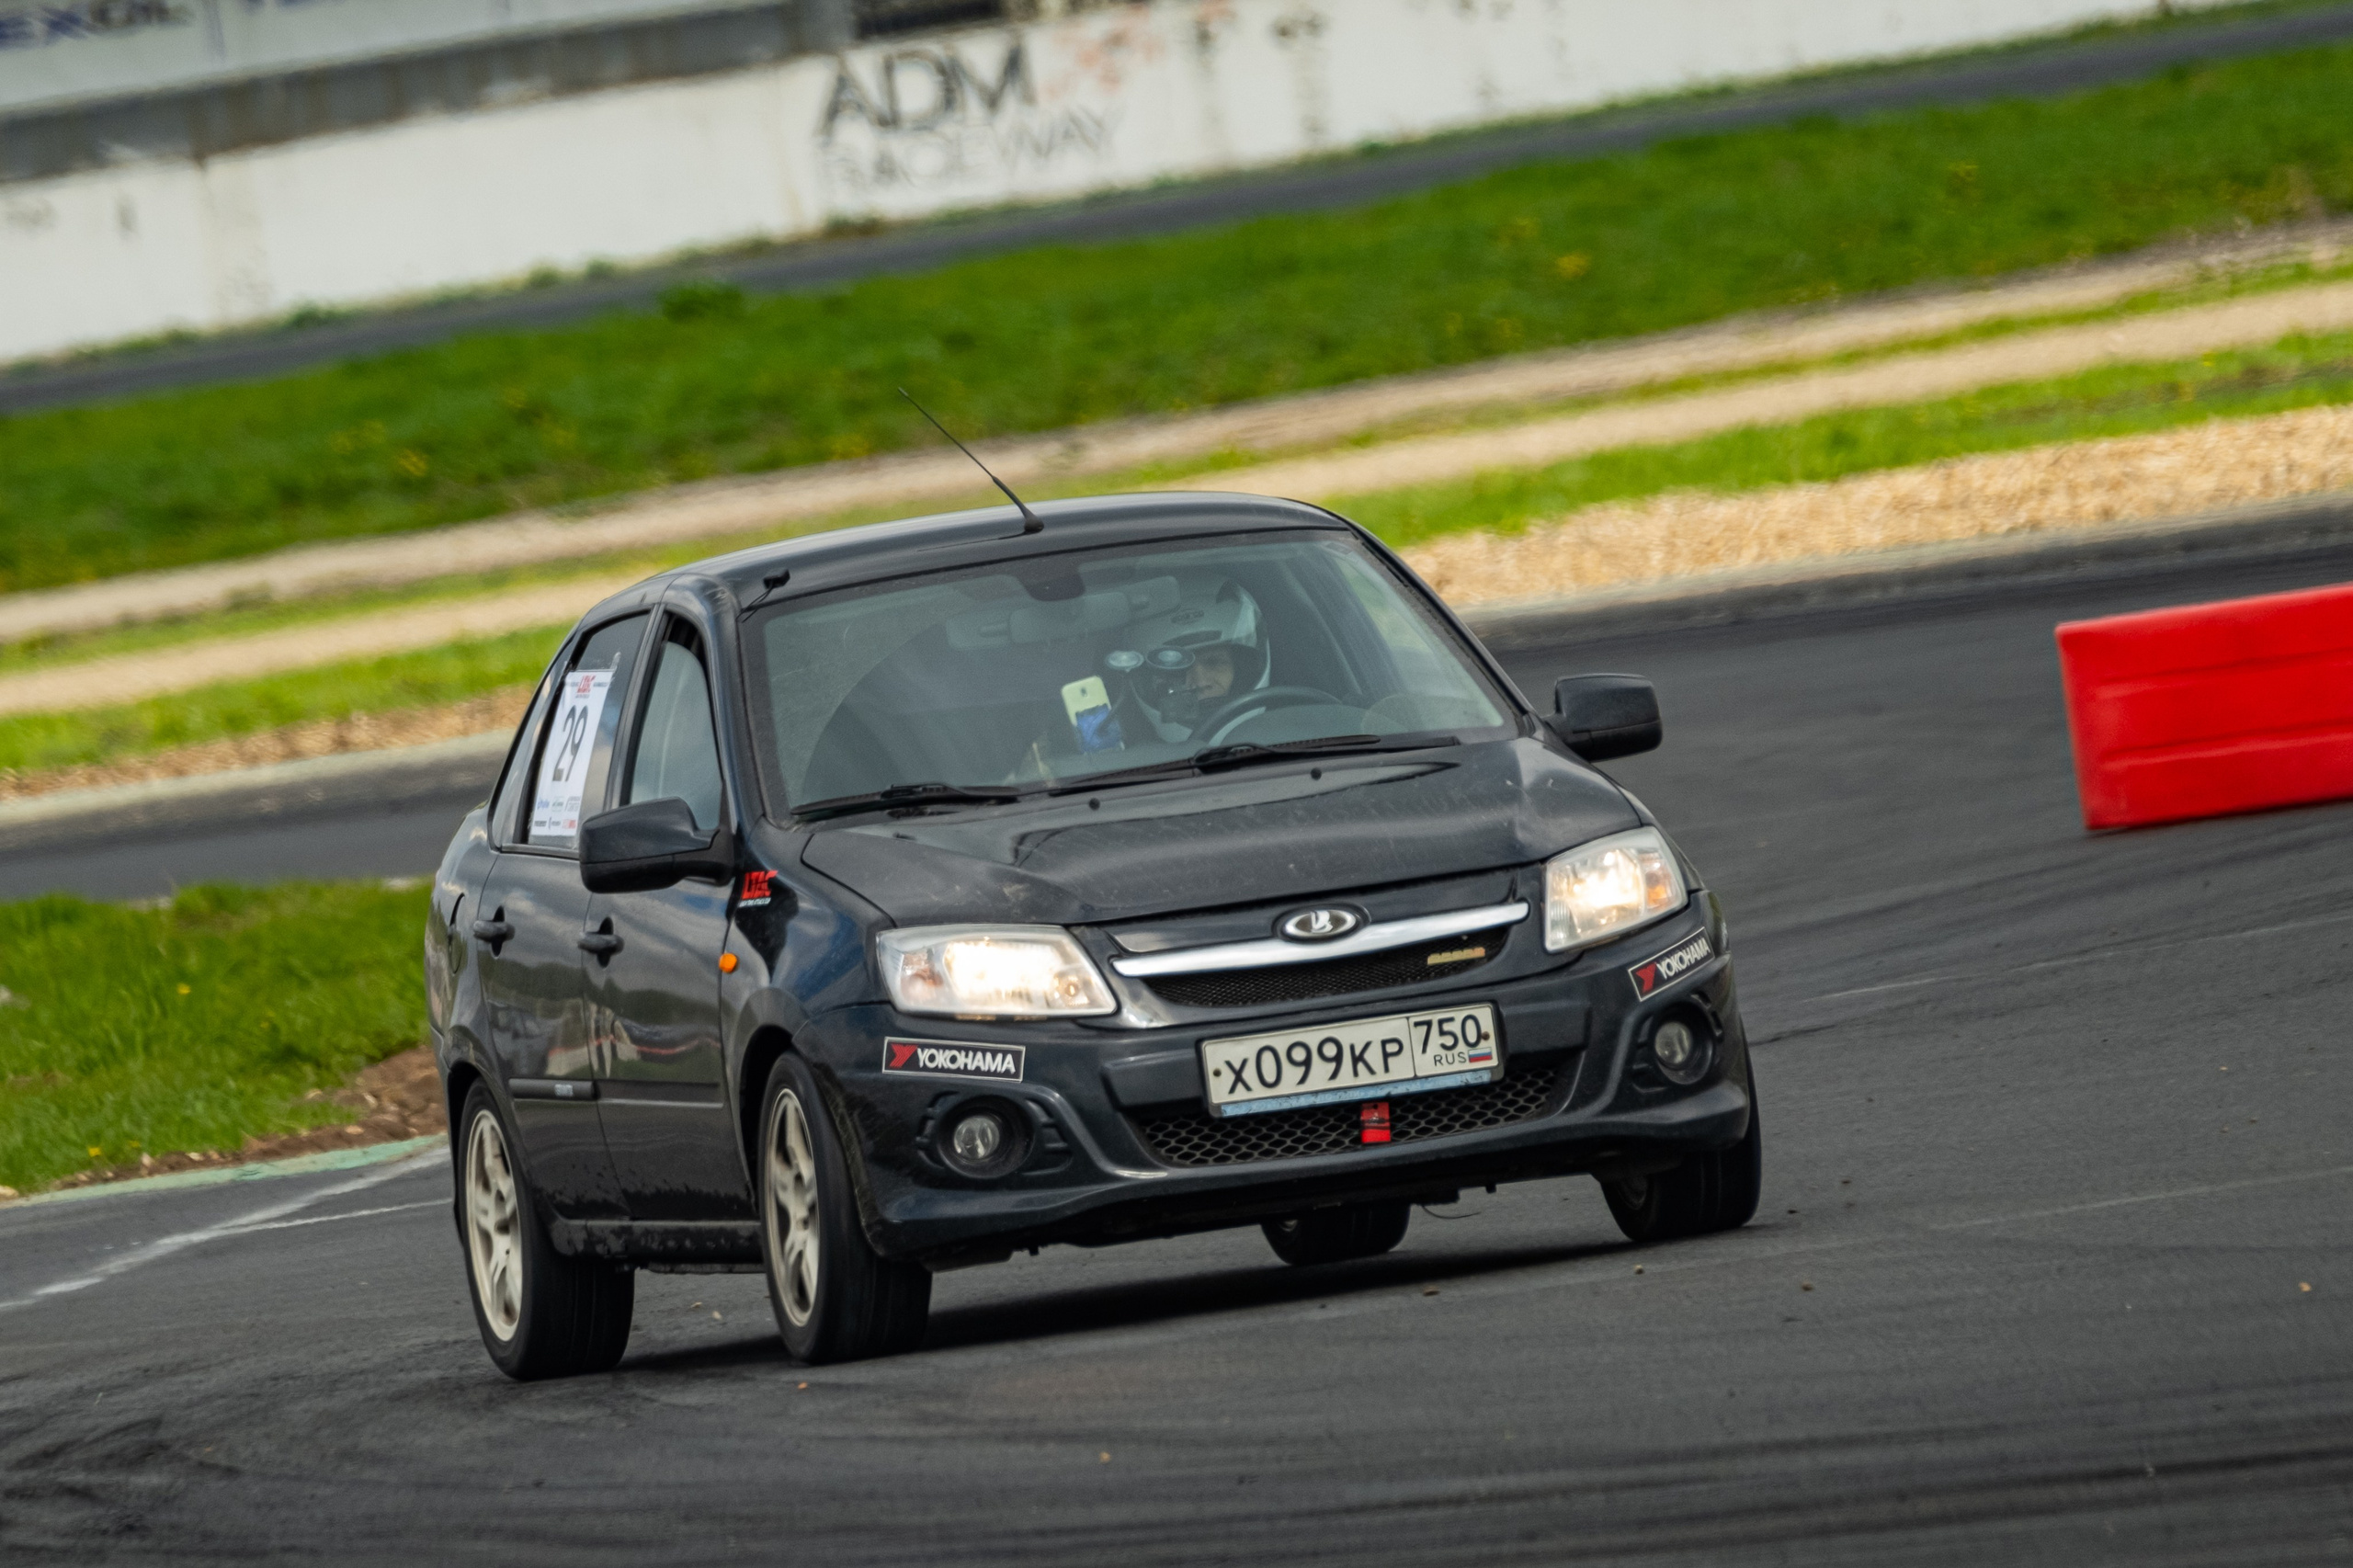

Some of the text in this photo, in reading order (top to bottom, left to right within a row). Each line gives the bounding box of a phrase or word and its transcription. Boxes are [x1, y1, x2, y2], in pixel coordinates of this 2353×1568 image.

[813, 41, 1039, 140] ADM
[551, 704, 589, 782] 29
[1656, 937, 1711, 980] YOKOHAMA
[1413, 1014, 1483, 1055] 750
[917, 1047, 1017, 1074] YOKOHAMA
[1433, 1051, 1467, 1067] RUS
